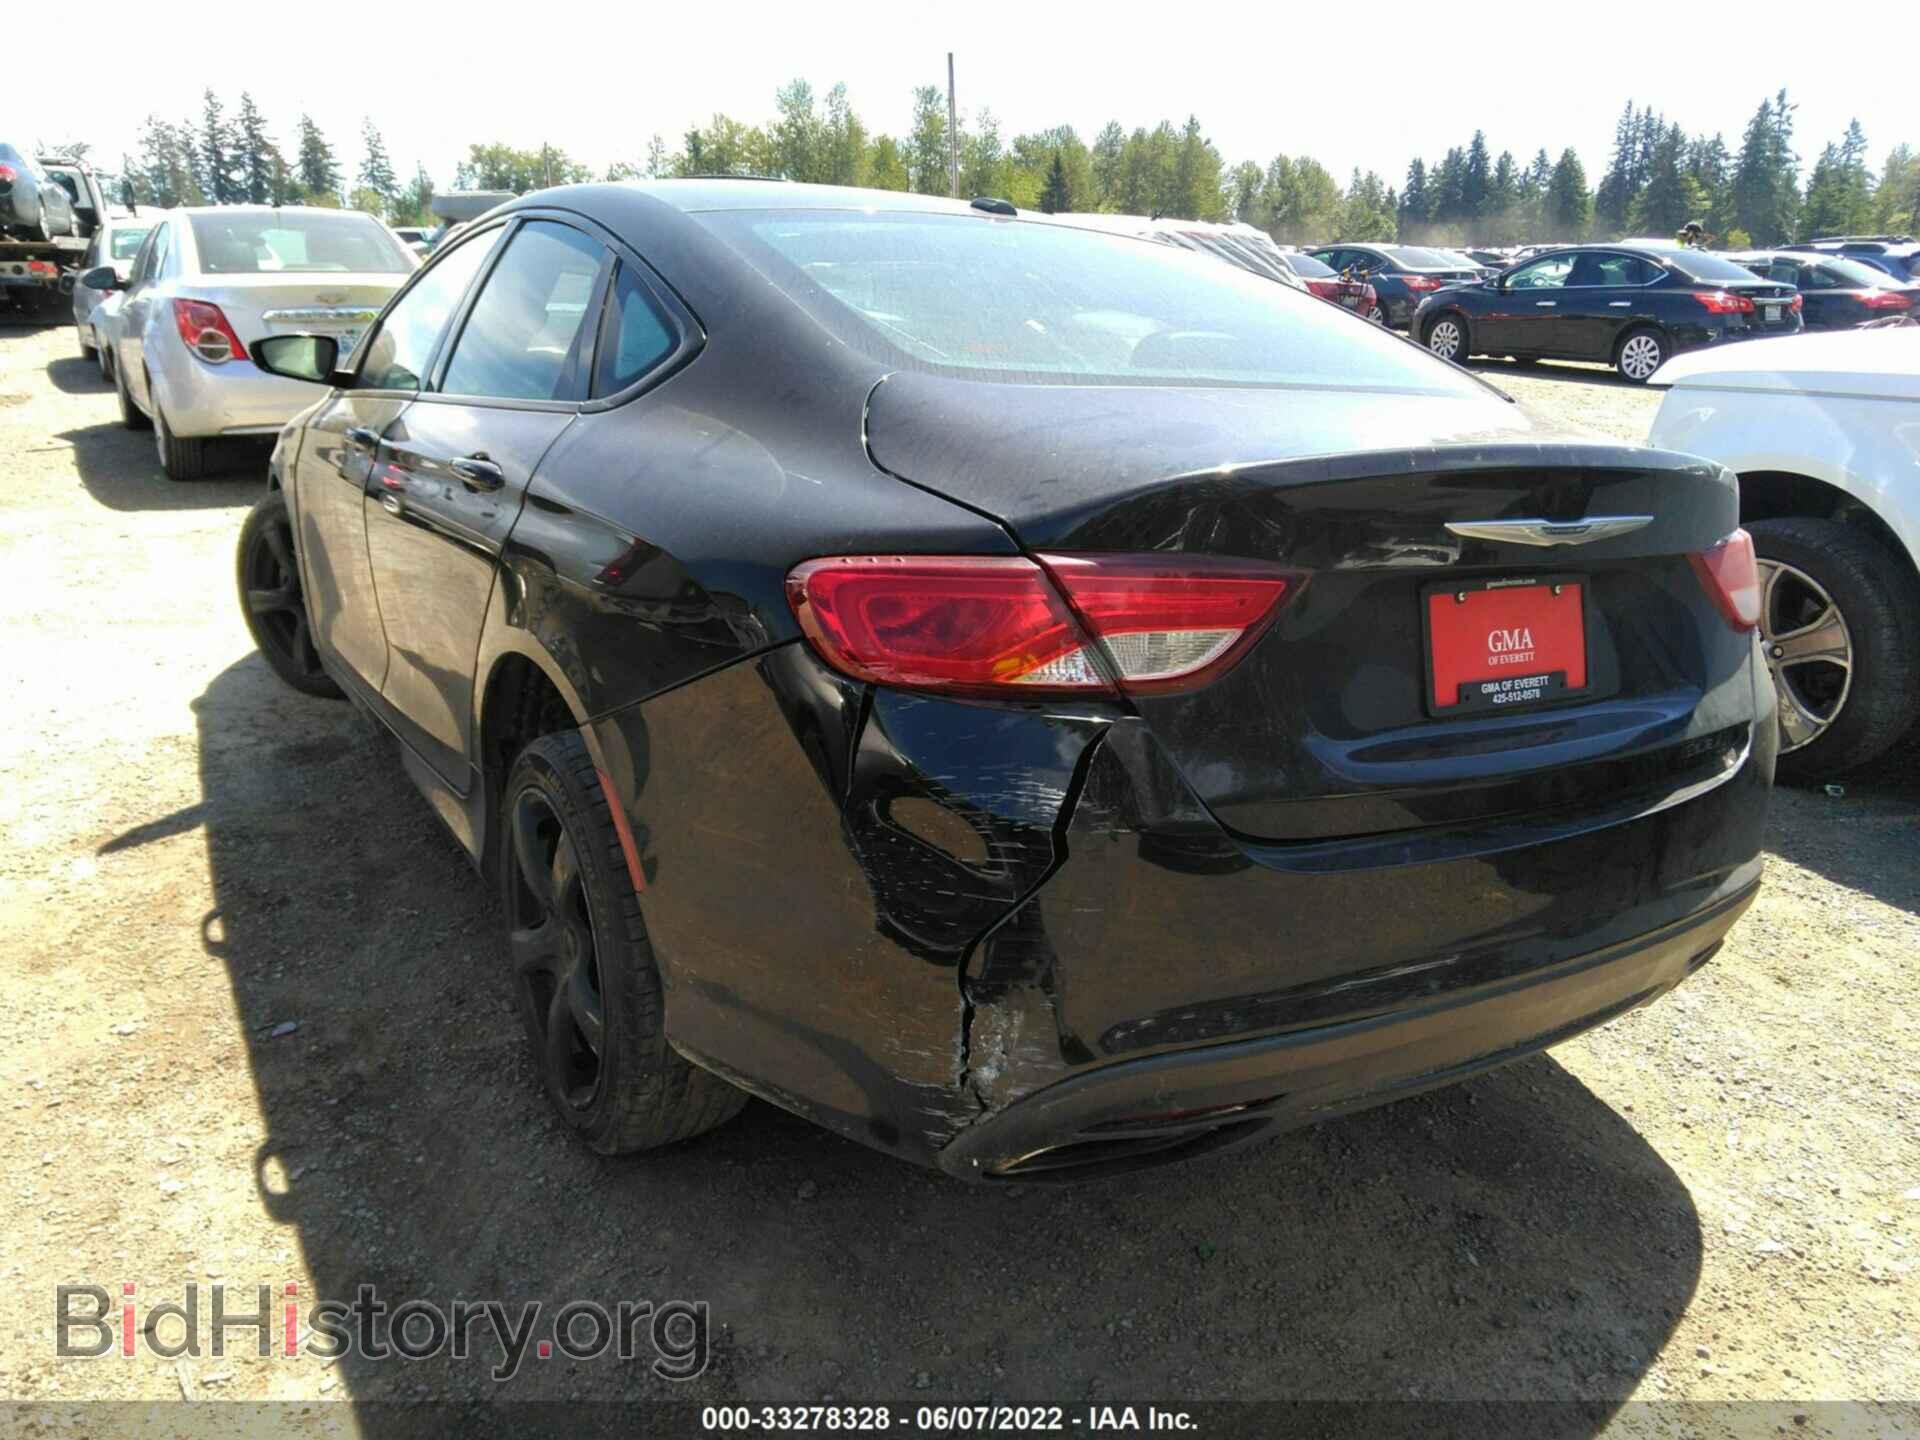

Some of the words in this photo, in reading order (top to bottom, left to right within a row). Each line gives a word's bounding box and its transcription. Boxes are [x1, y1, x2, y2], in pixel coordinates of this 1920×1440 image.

[1488, 628, 1534, 652] GMA
[1488, 655, 1498, 666] OF
[1500, 652, 1535, 664] EVERETT
[1481, 682, 1500, 694] GMA
[1502, 680, 1513, 691] OF
[1514, 676, 1549, 690] EVERETT
